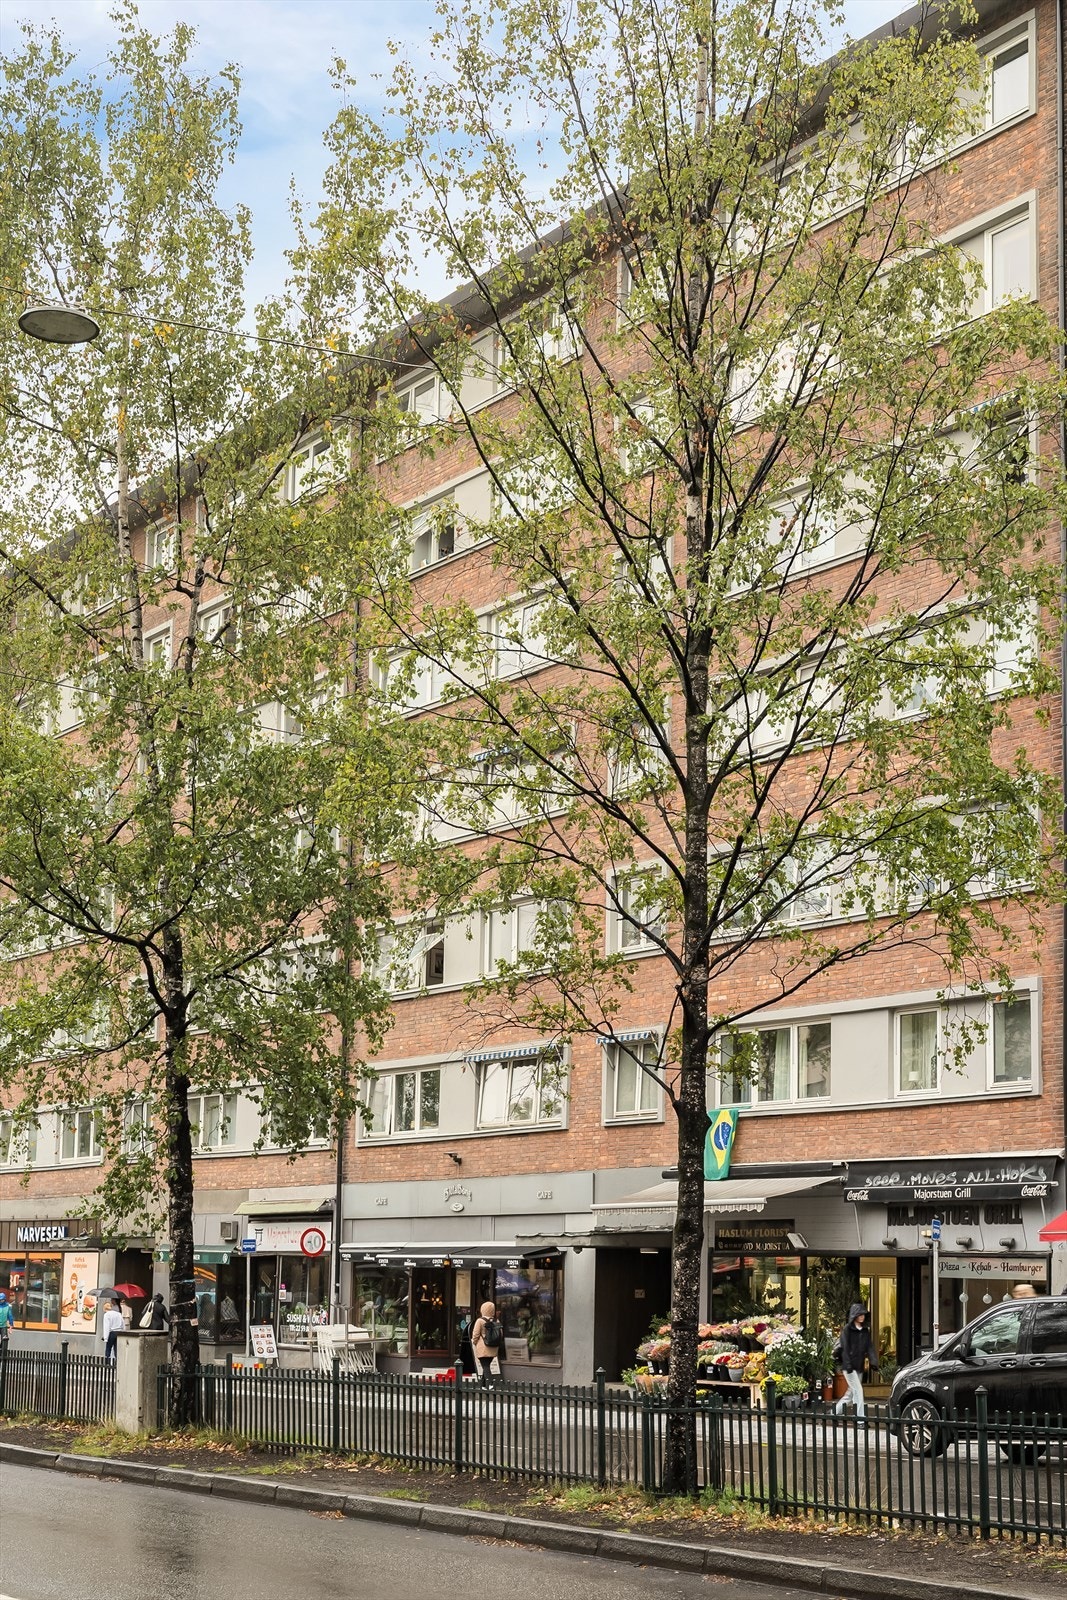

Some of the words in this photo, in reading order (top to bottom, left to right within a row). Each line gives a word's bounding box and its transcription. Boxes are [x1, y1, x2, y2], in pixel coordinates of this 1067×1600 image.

[913, 1188, 952, 1200] Majorstuen
[954, 1187, 971, 1198] Grill
[887, 1204, 980, 1226] MAJORSTUEN
[984, 1203, 1022, 1225] GRILL
[17, 1226, 65, 1242] NARVESEN
[719, 1228, 752, 1238] HASLUM
[754, 1228, 790, 1237] FLORIST
[939, 1261, 960, 1272] Pizza
[1000, 1261, 1043, 1276] Hamburger
